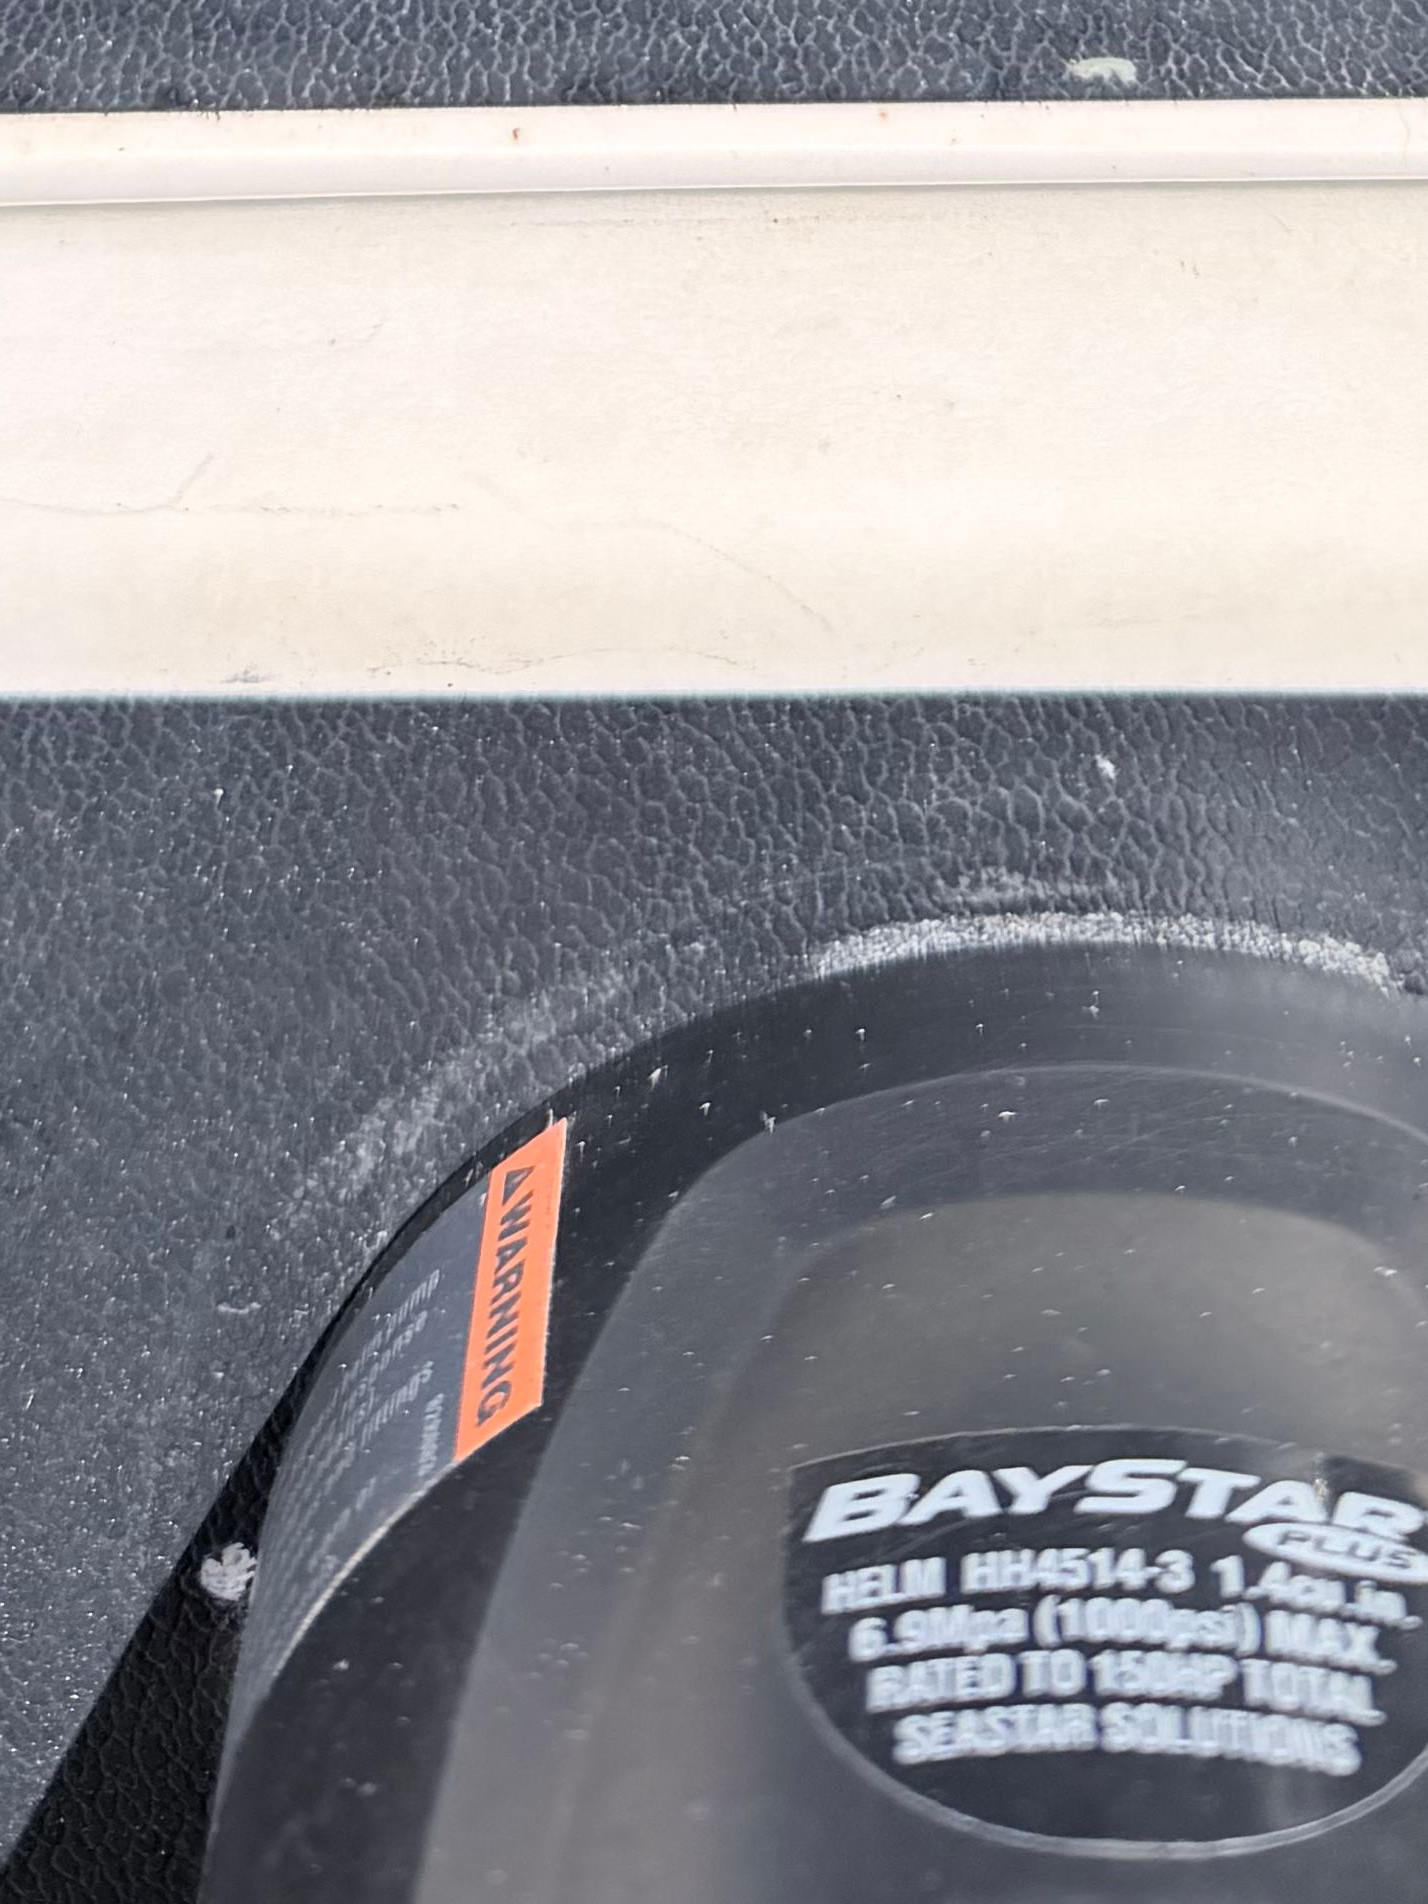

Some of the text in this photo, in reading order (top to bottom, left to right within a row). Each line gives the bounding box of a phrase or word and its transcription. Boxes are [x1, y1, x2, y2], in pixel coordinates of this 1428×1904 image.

[475, 1194, 533, 1428] WARNING
[821, 1556, 947, 1615] HELM
[960, 1547, 1195, 1595] HH4514-3
[1275, 1529, 1418, 1570] PLUS
[865, 1652, 1017, 1714] RATED
[1019, 1648, 1088, 1697] TO
[893, 1701, 1363, 1777] SEASTAR SOLUTIONS
